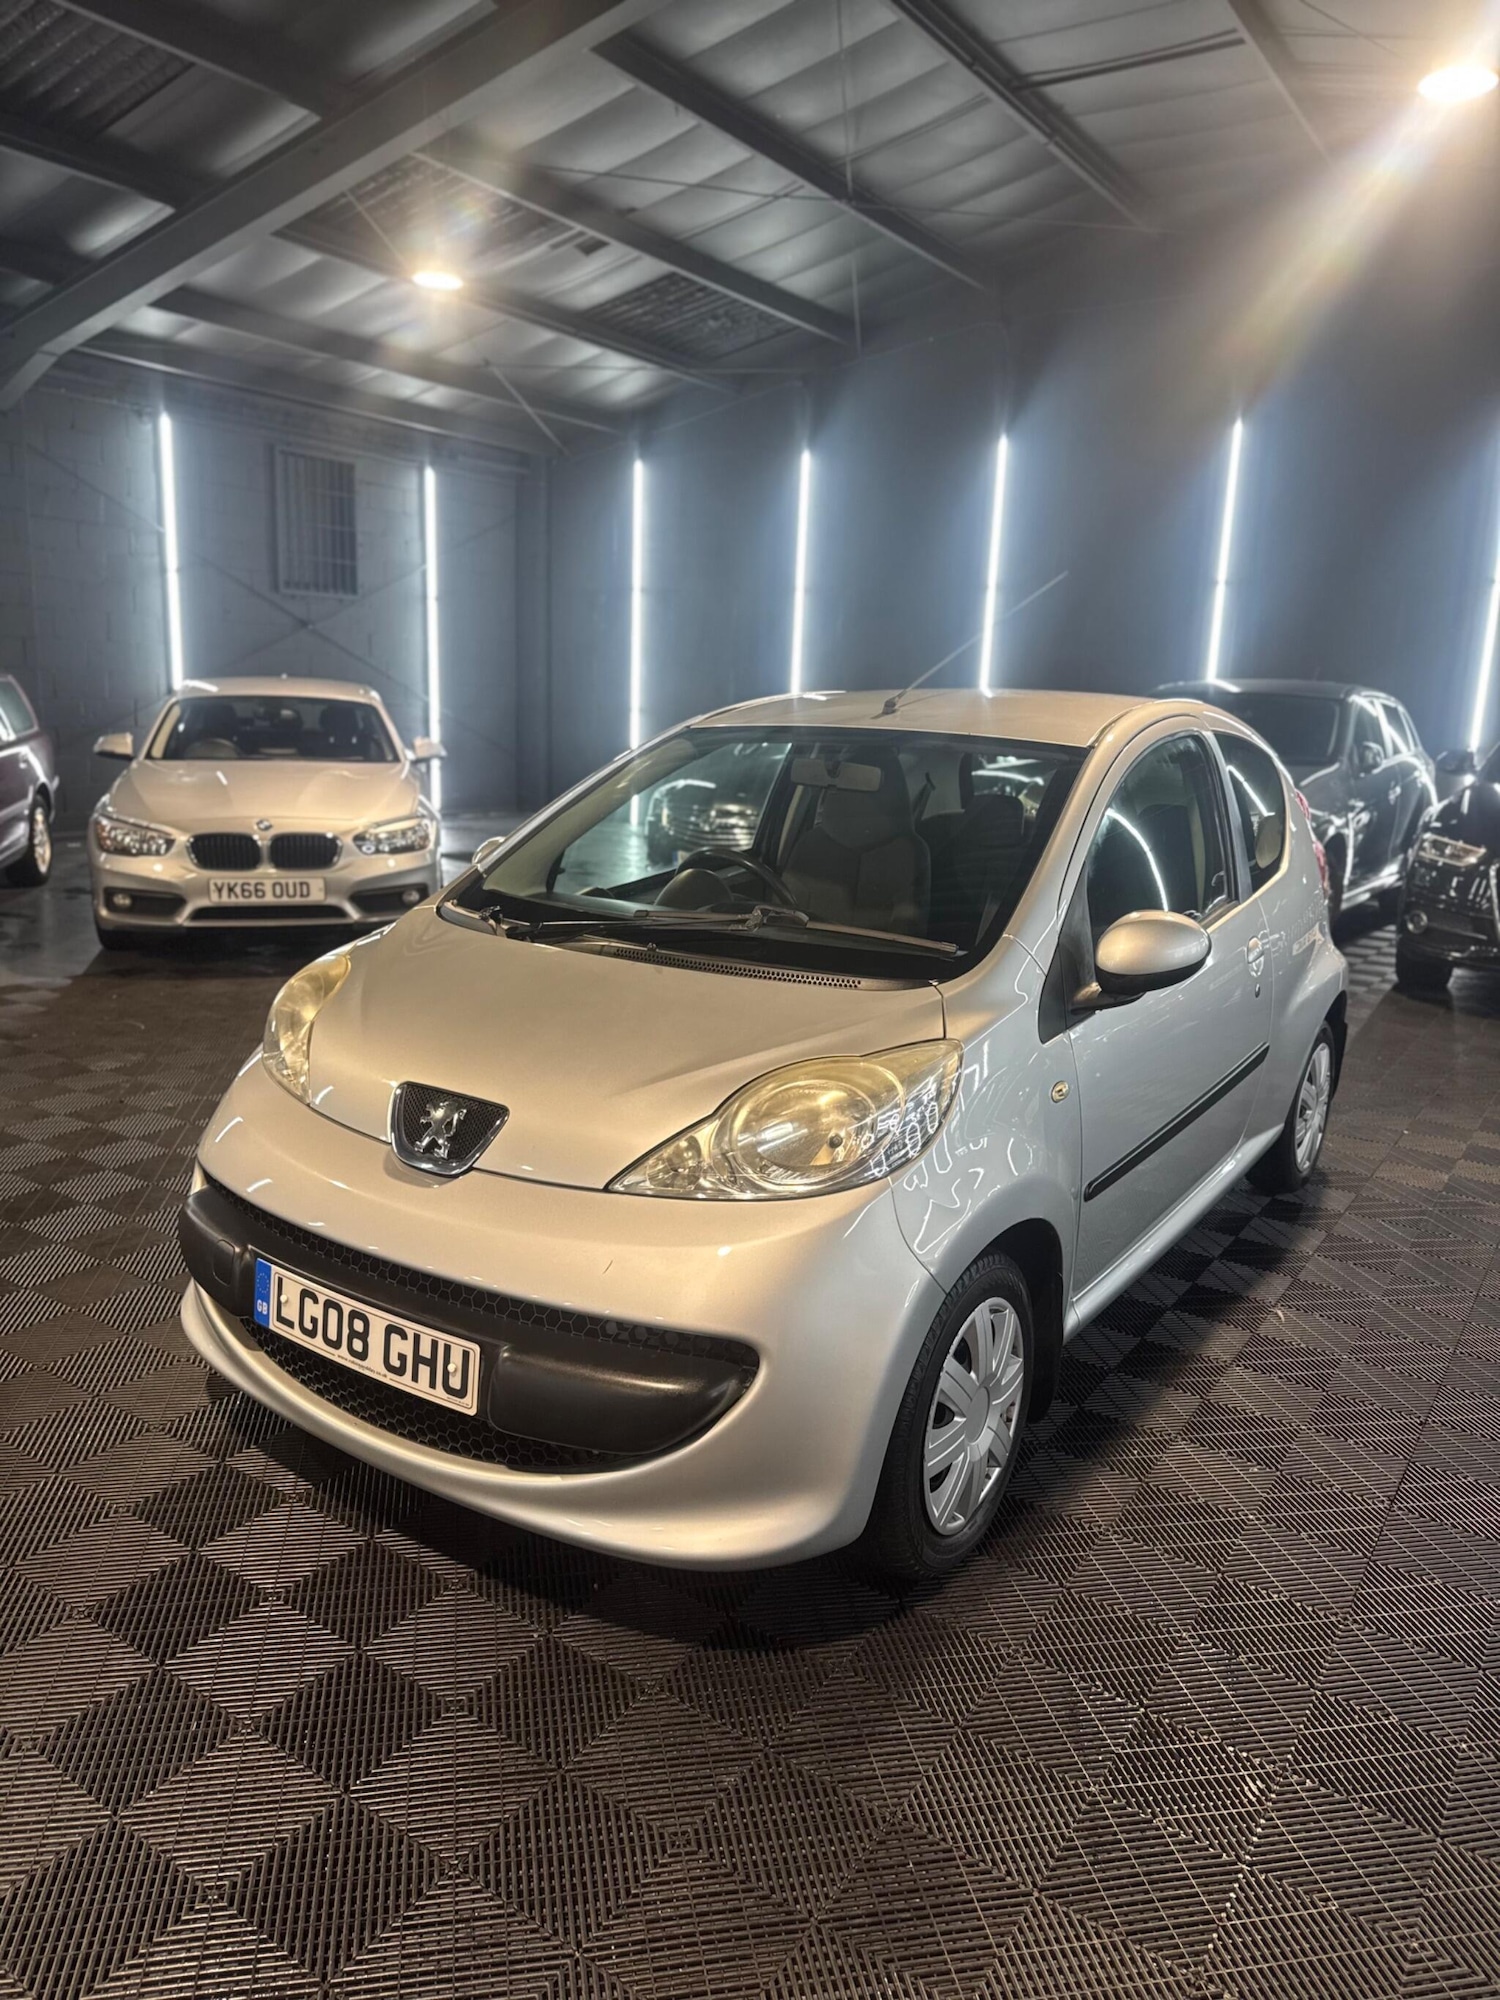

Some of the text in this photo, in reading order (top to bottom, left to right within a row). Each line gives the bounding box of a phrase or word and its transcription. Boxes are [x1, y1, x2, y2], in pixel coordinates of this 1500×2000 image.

[213, 881, 311, 899] YK66 OUD
[256, 1299, 268, 1315] GB
[276, 1276, 470, 1399] LG08 GHU
